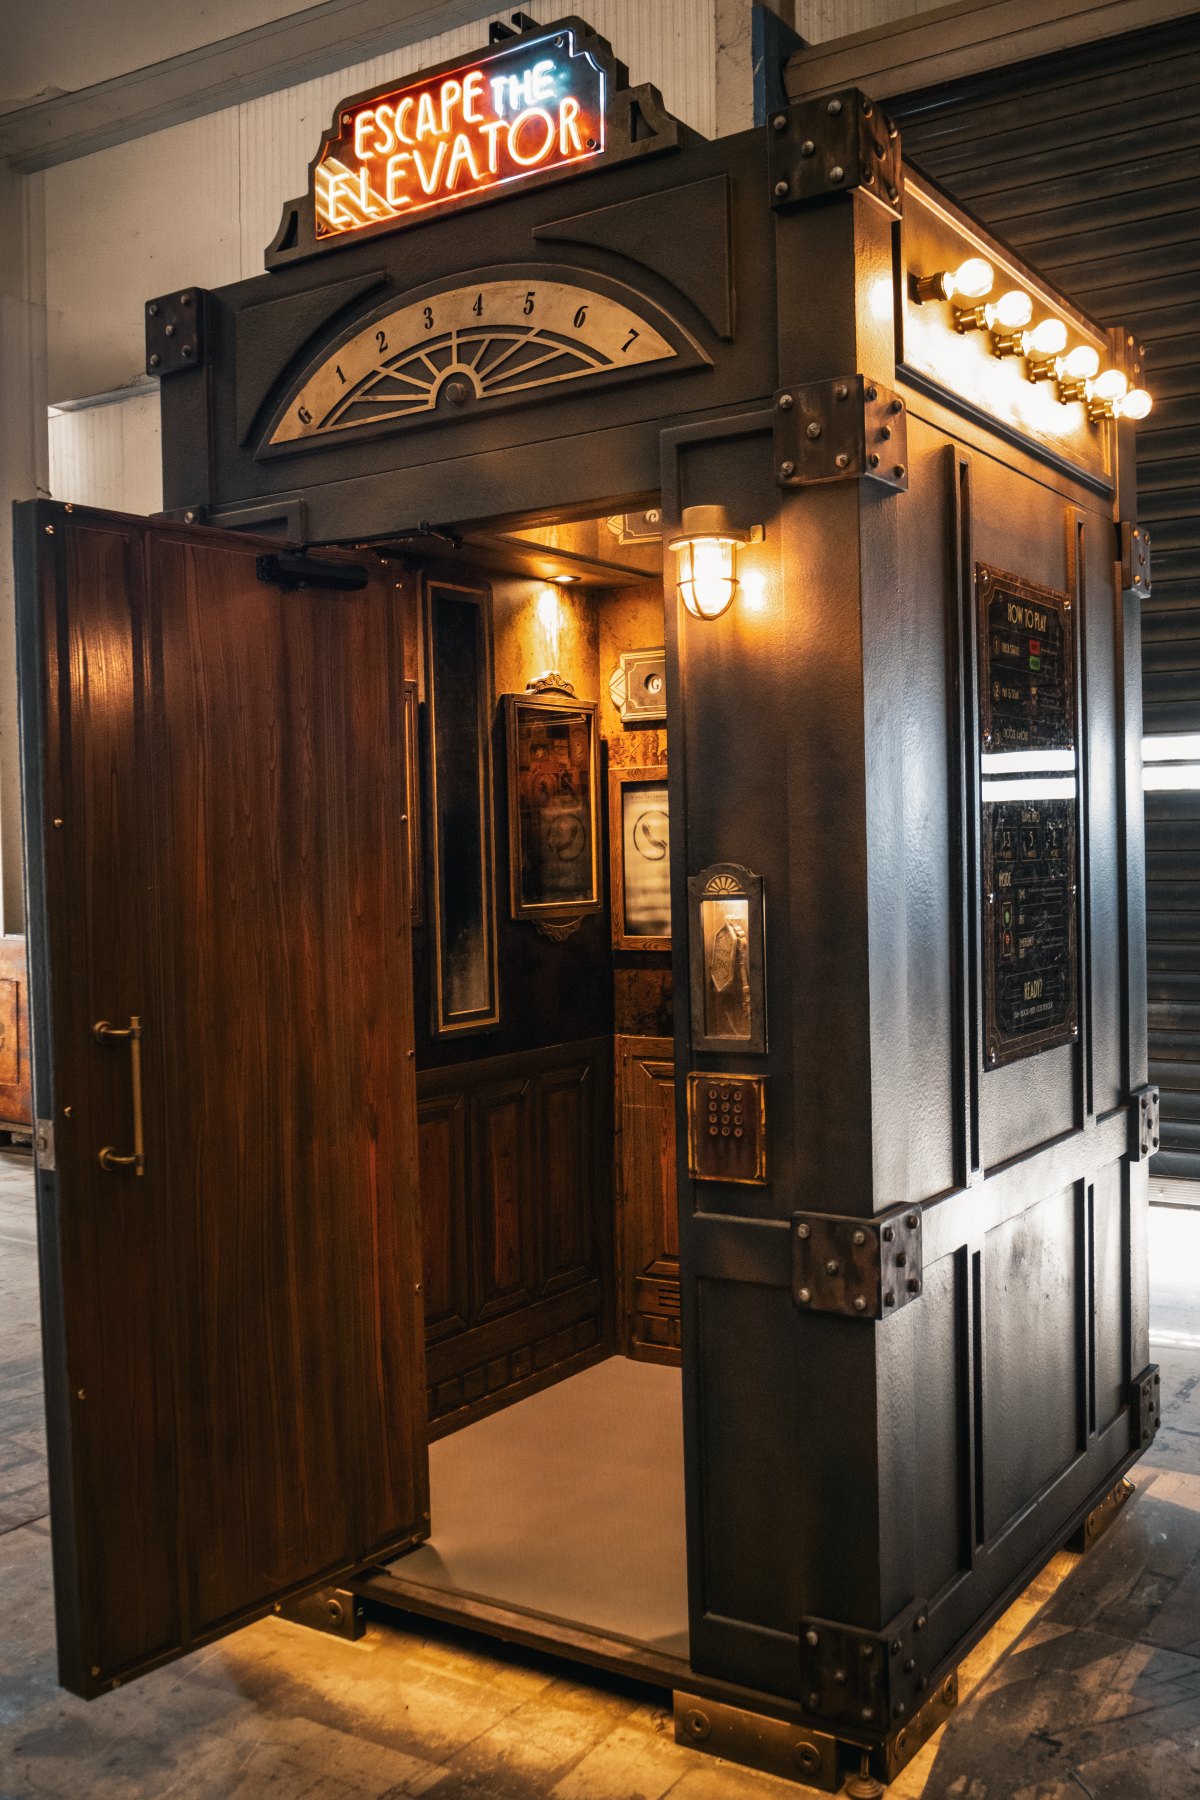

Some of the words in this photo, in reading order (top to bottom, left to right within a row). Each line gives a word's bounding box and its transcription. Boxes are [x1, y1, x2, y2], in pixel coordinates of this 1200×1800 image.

[354, 71, 483, 160] ESCAPE
[490, 59, 556, 118] THE
[328, 97, 582, 224] ELEVATOR
[296, 406, 313, 425] G
[335, 365, 347, 385] 1
[375, 331, 389, 353] 2
[423, 307, 435, 330] 3
[472, 293, 484, 317] 4
[523, 291, 536, 316] 5
[573, 305, 589, 329] 6
[620, 329, 640, 353] 7
[1007, 602, 1023, 625] HOW
[1024, 608, 1034, 628] TO
[1034, 611, 1047, 632] PLAY
[651, 677, 660, 690] G
[1024, 978, 1043, 1000] READY?
